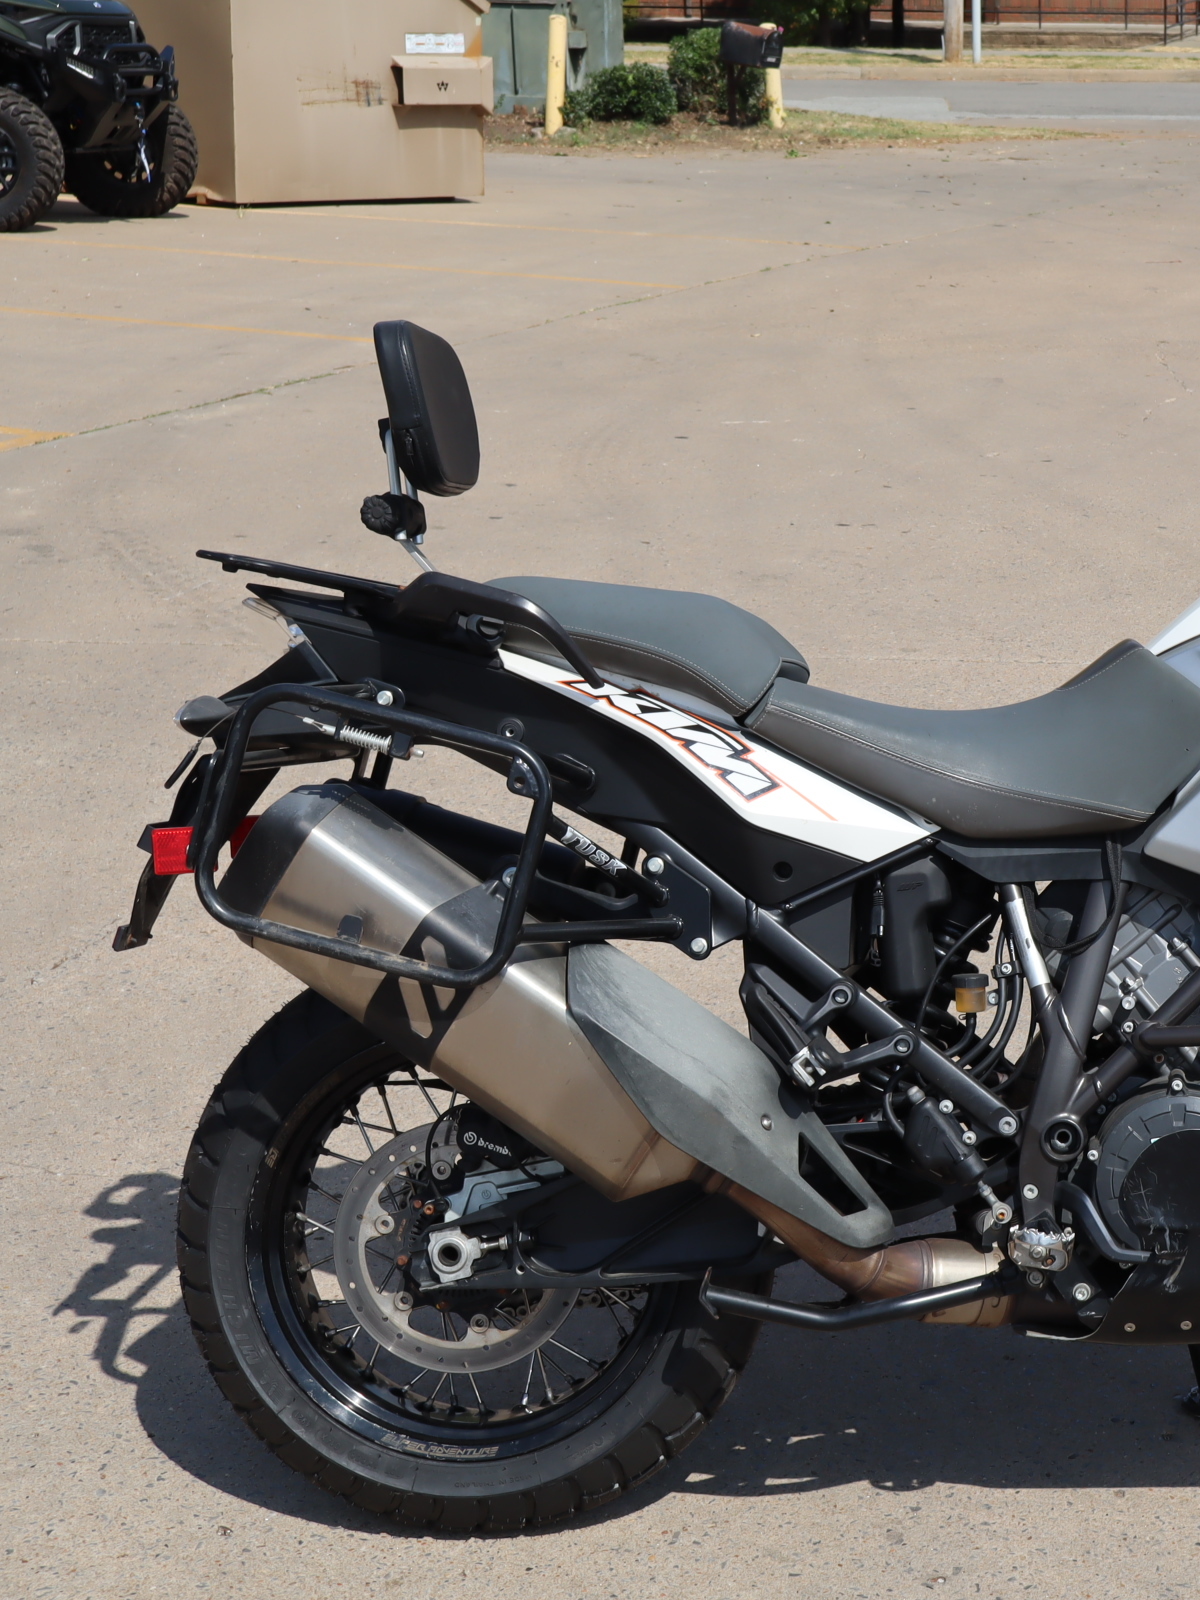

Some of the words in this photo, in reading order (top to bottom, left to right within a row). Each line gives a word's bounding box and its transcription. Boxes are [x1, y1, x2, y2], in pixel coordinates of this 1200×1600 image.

[557, 680, 782, 802] KTM
[560, 825, 628, 876] TUSK
[427, 1445, 500, 1458] ADVENTURE
